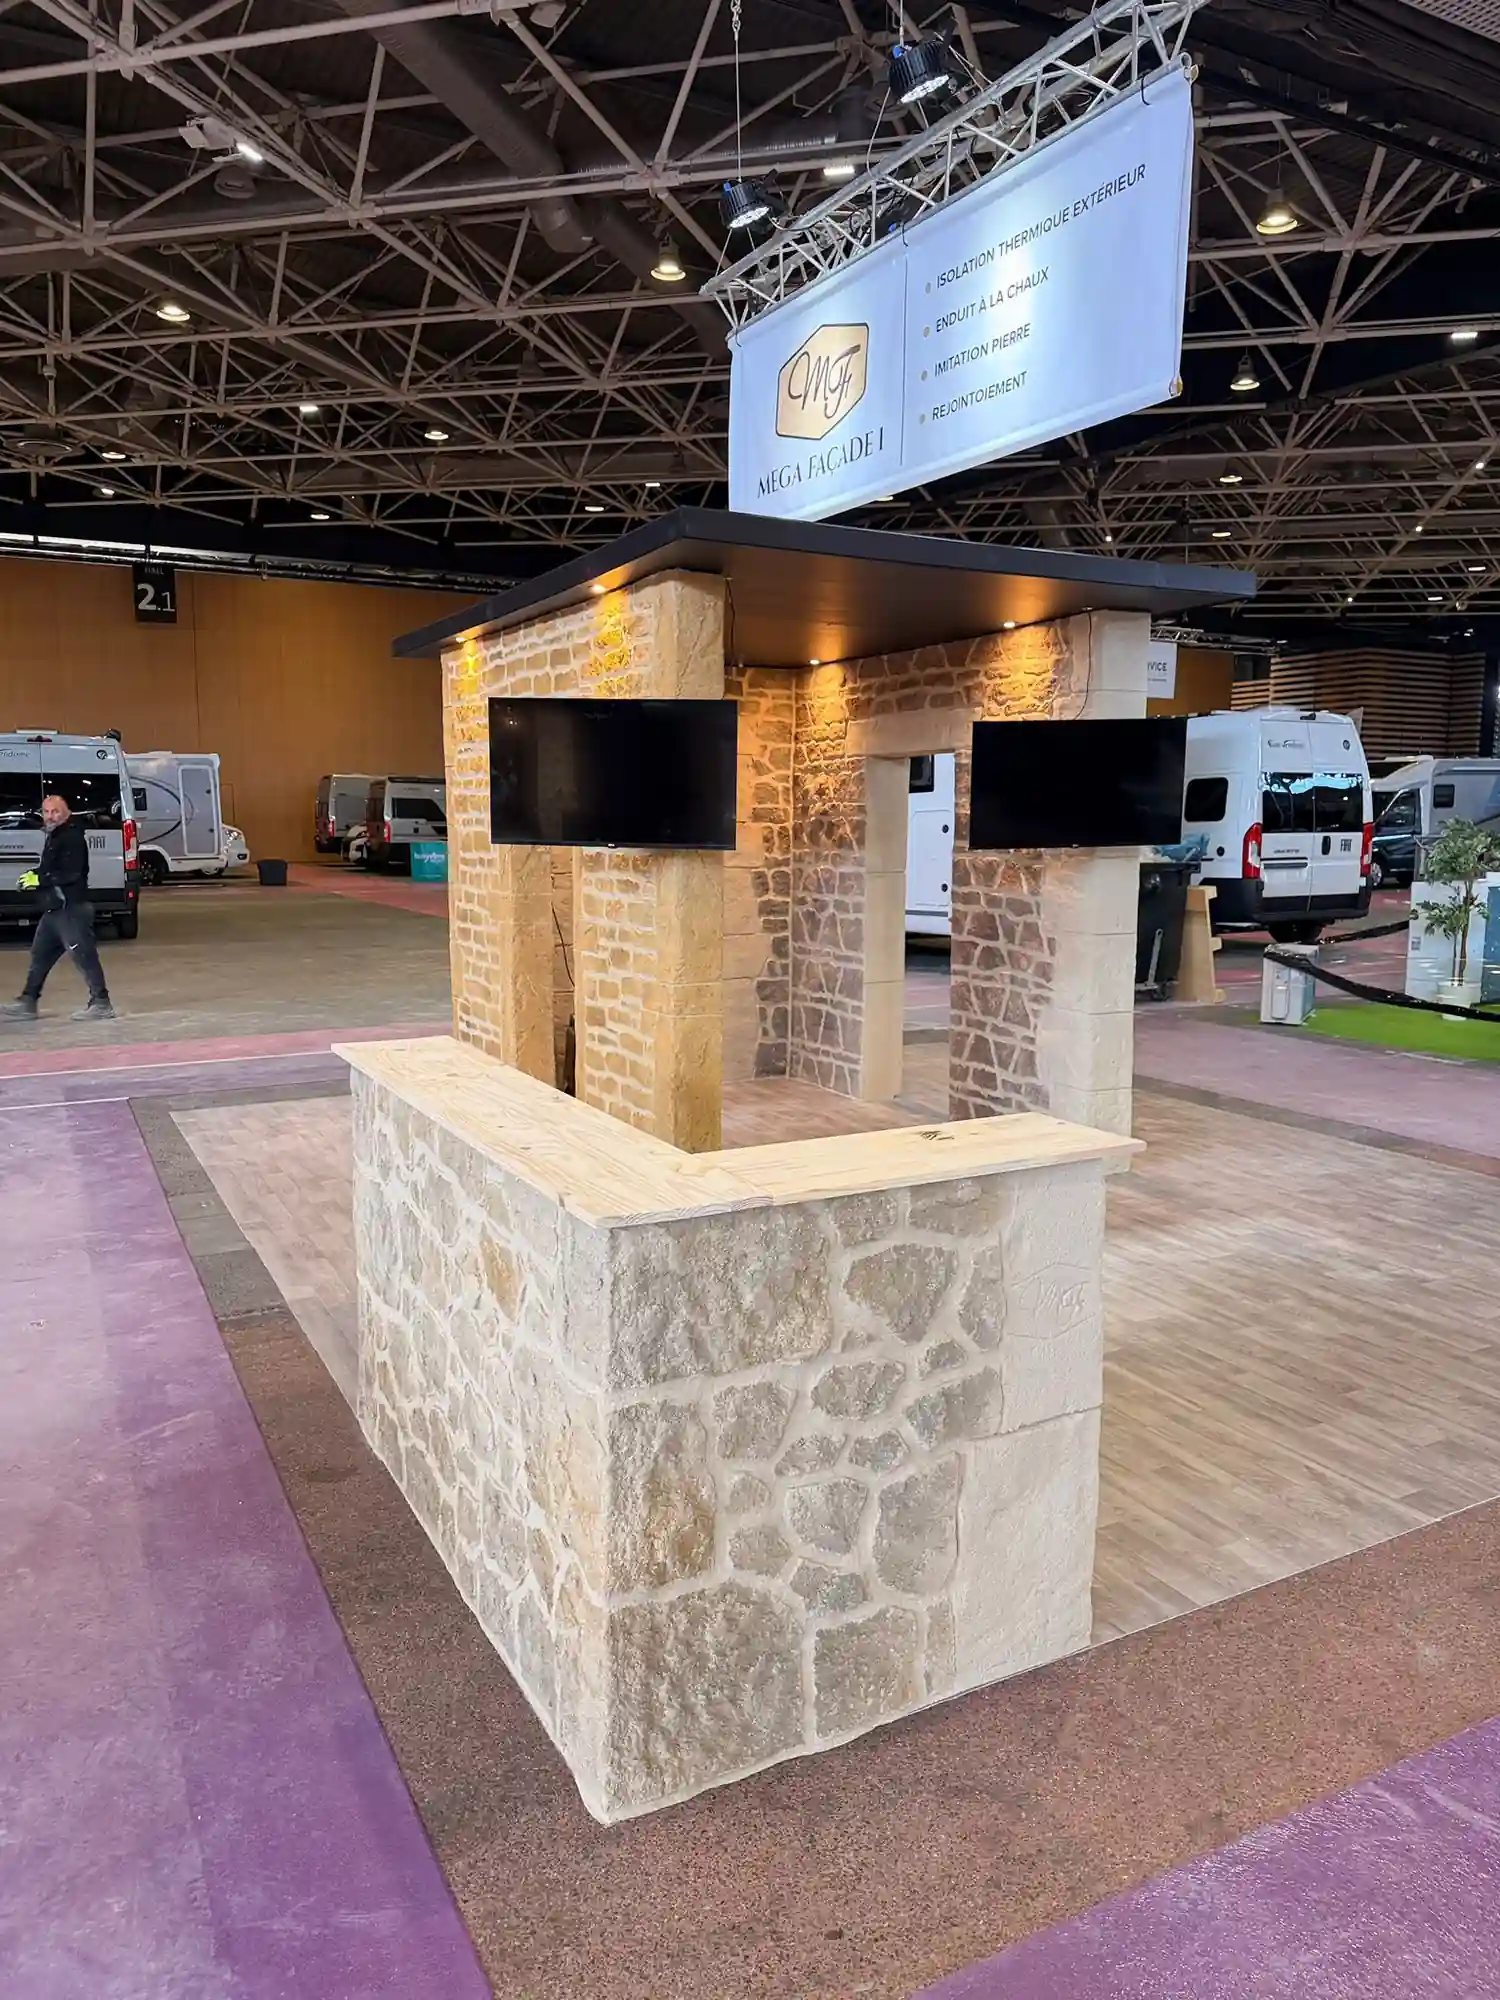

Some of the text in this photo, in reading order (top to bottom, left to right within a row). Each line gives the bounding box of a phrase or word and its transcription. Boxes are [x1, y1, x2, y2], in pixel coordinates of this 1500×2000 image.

[936, 163, 1146, 288] ISOLATION THERMIQUE EXTÉRIEUR
[935, 266, 1050, 333] ENDUIT À LA CHAUX
[934, 322, 1031, 378] IMITATION PIERRE
[932, 370, 1028, 421] REJOINTOIEMENT
[757, 461, 802, 499] MEGA
[807, 430, 874, 481] FAÇADE
[137, 583, 176, 612] 2.1
[89, 836, 107, 849] FIAT
